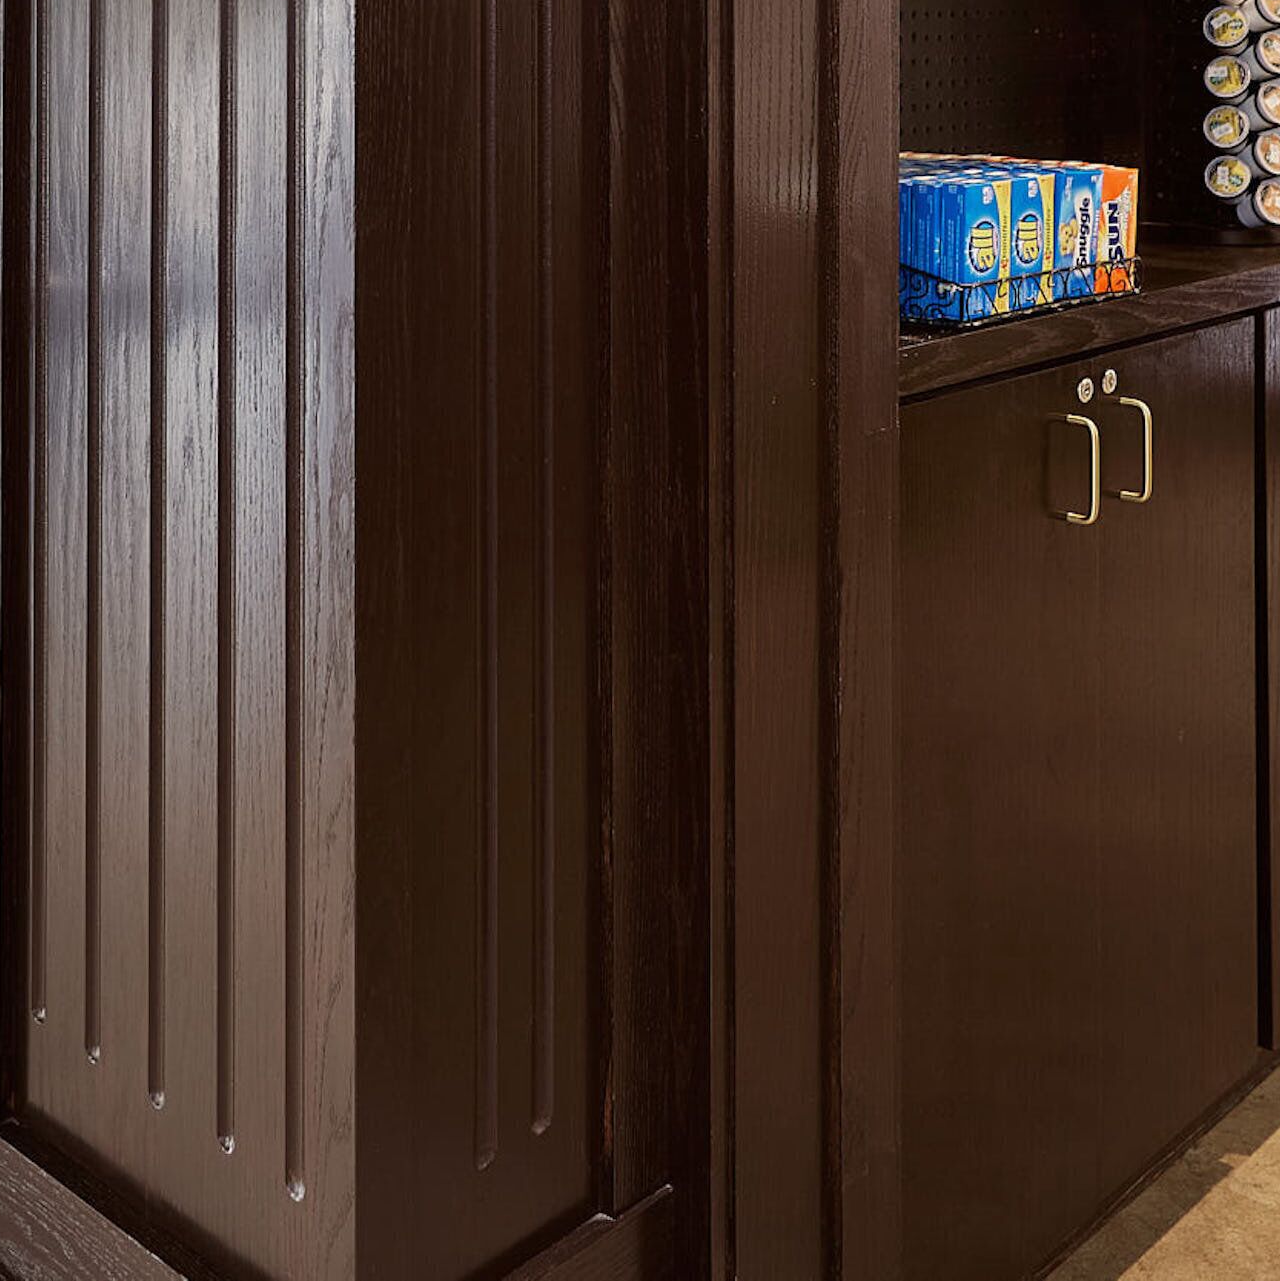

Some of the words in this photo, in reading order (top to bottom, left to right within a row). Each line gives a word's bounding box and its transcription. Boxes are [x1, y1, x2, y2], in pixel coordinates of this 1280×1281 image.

[971, 227, 995, 269] all
[1018, 220, 1038, 261] all
[1076, 197, 1091, 268] Snuggle
[1108, 202, 1125, 264] SUN
